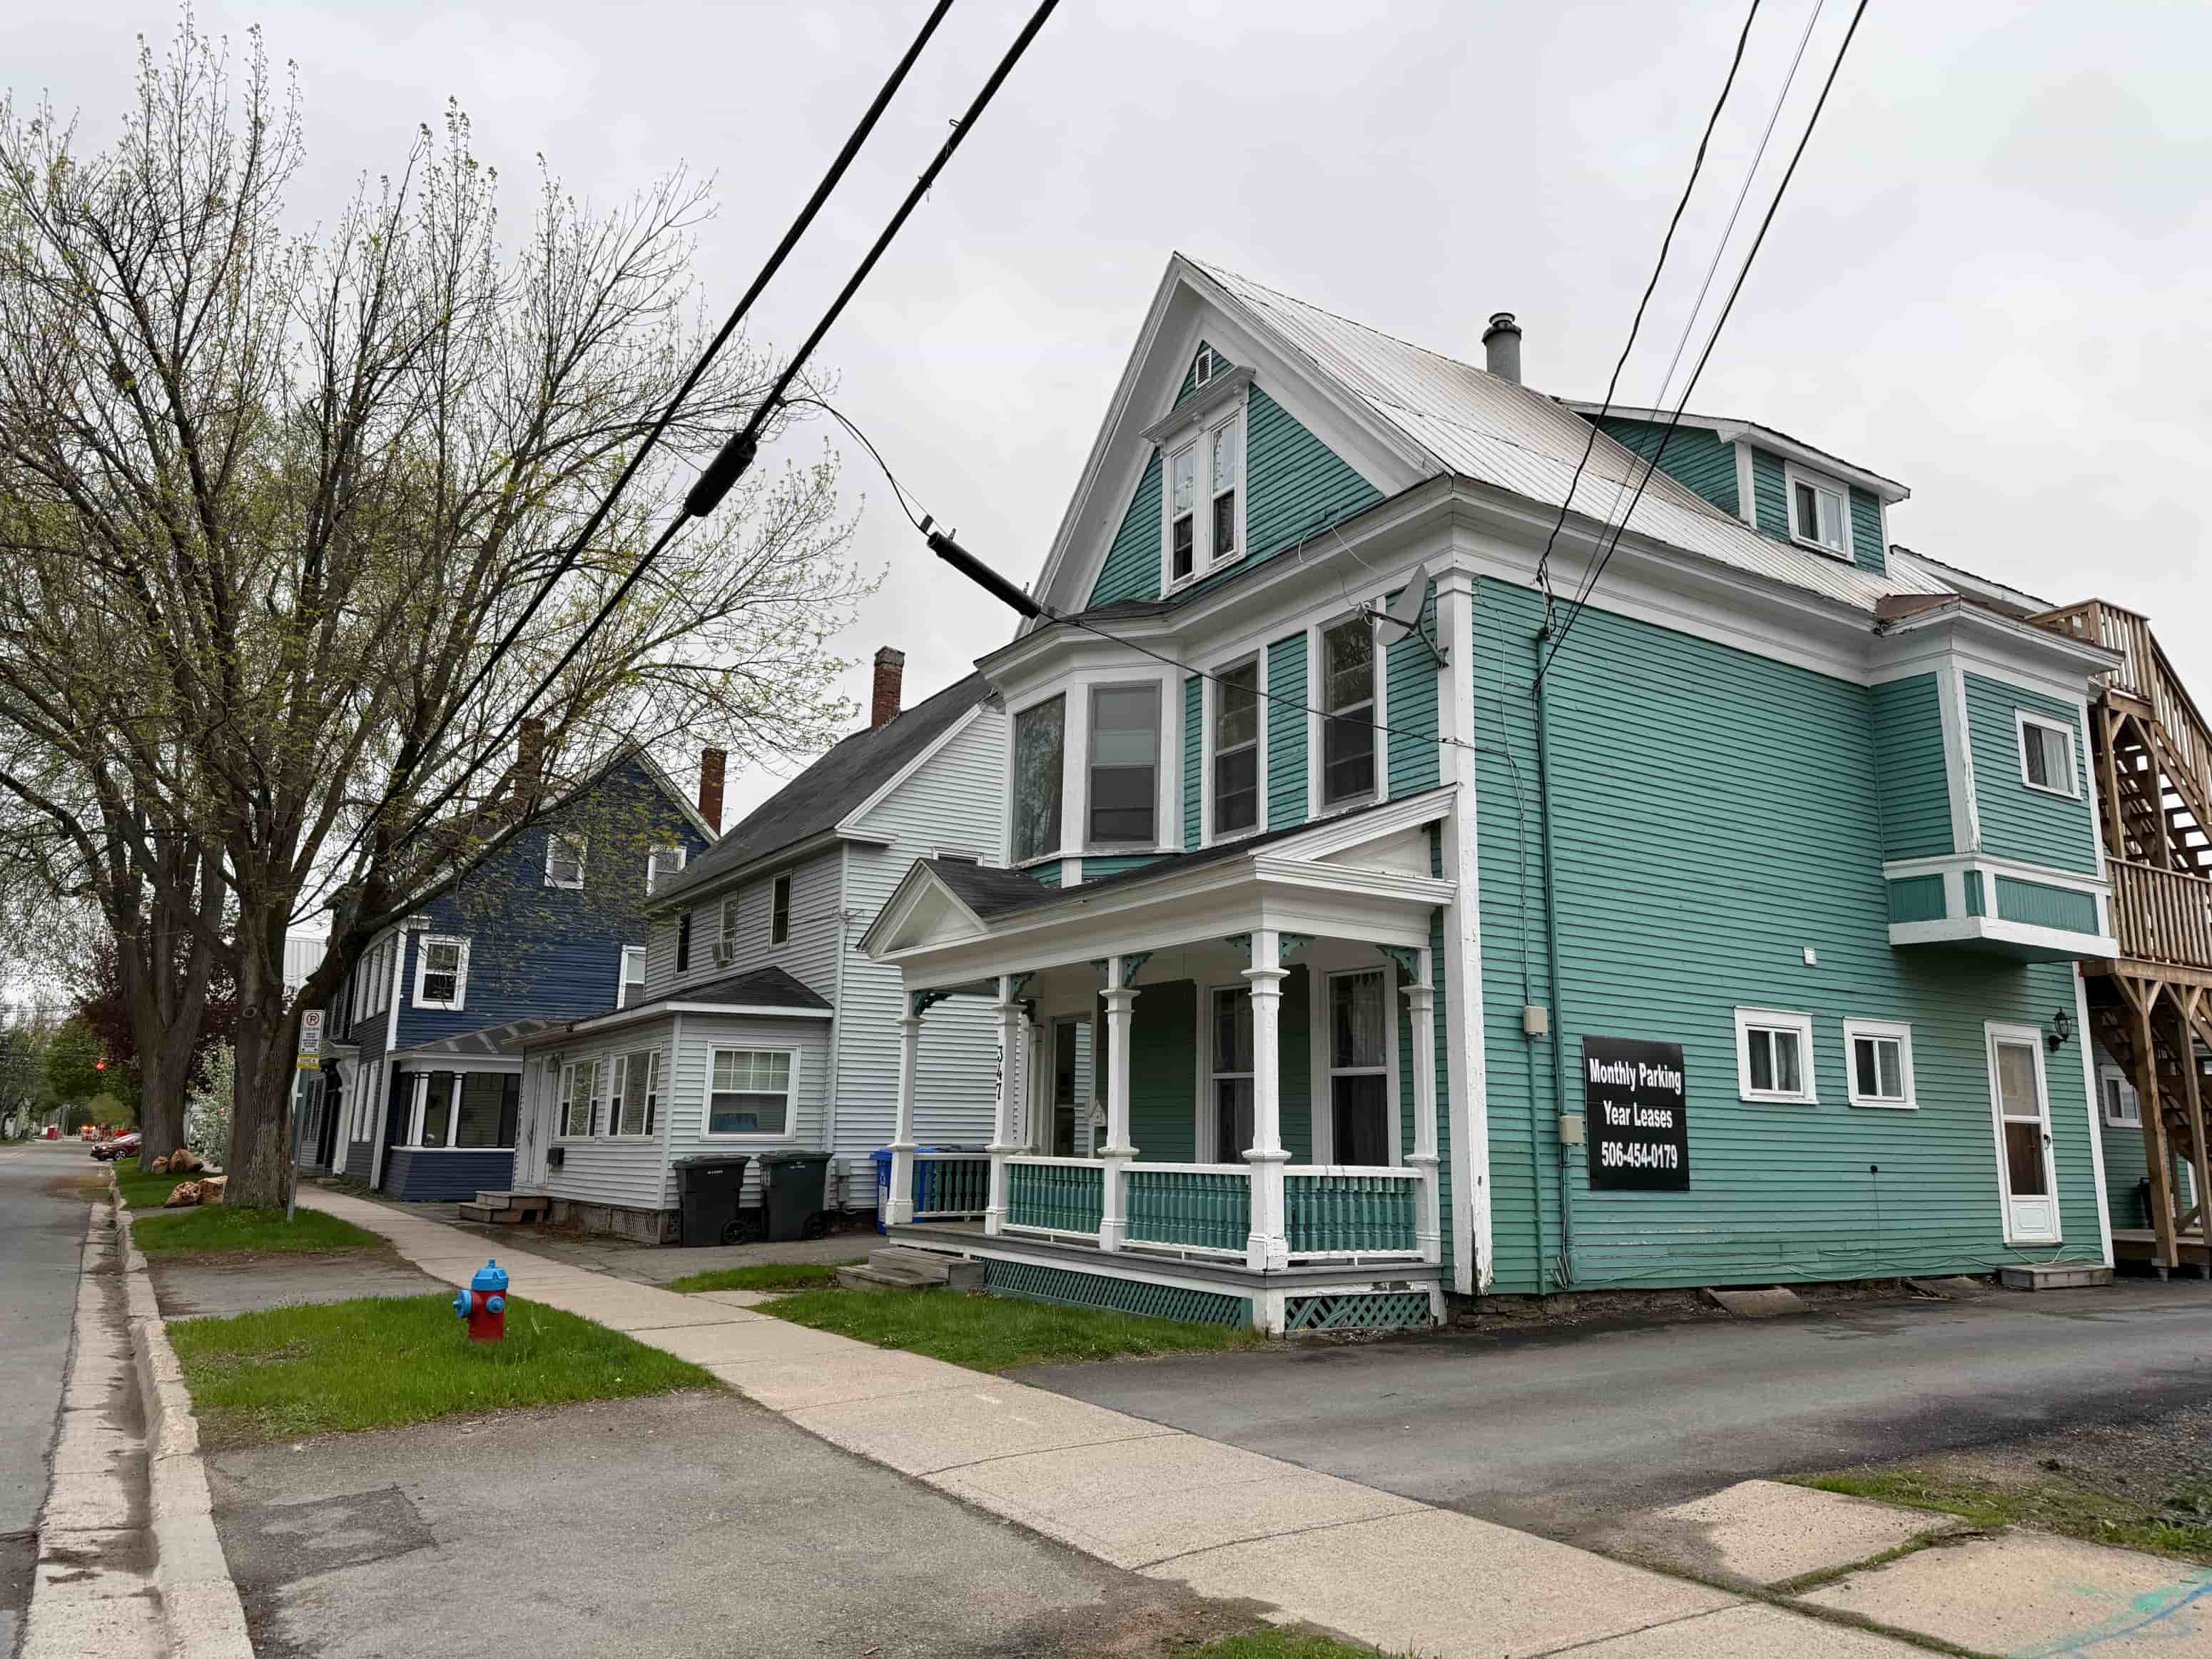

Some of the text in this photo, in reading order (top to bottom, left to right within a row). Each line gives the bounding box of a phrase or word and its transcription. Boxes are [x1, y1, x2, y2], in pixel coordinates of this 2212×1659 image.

[1589, 1058, 1681, 1095] Monthly Parking
[1603, 1100, 1673, 1128] Year Leases
[1601, 1142, 1678, 1169] 506-454-0179
